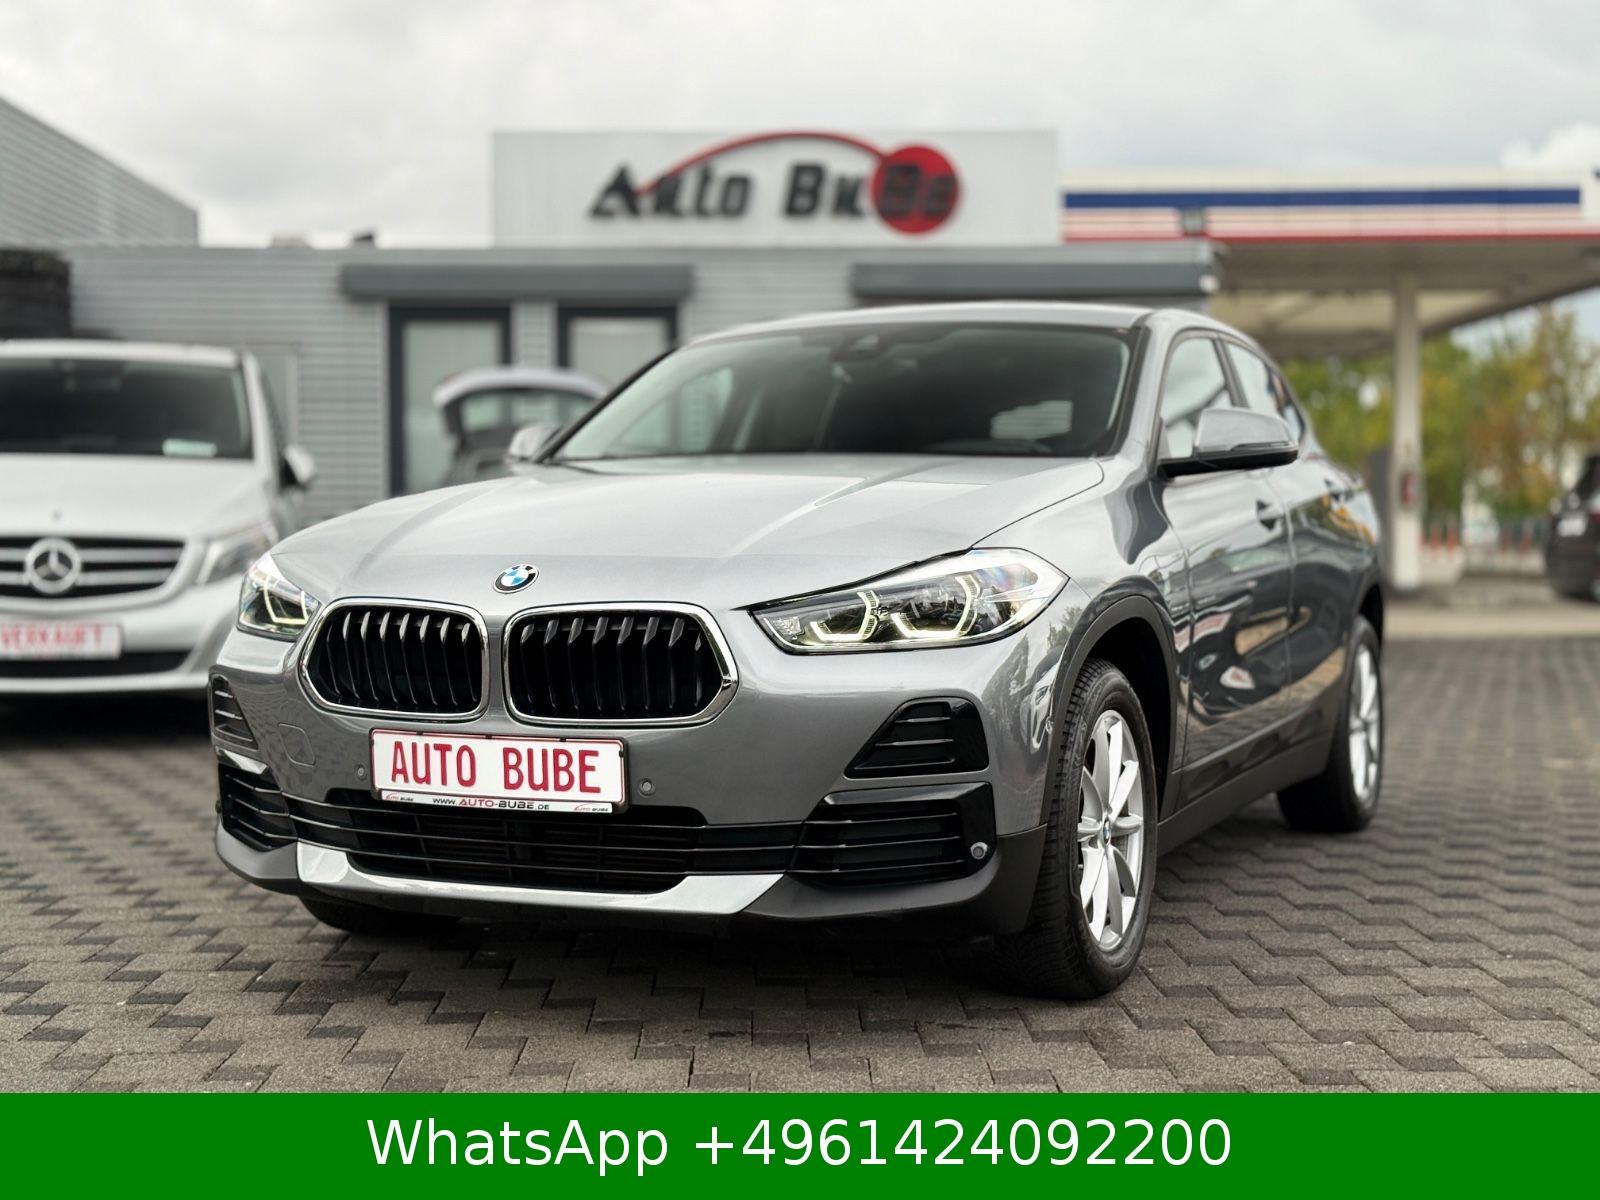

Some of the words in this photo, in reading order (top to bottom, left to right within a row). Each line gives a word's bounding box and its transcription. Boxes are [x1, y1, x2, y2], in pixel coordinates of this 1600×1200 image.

[589, 164, 752, 219] Auto
[391, 740, 477, 787] AUTO
[502, 747, 602, 794] BUBE
